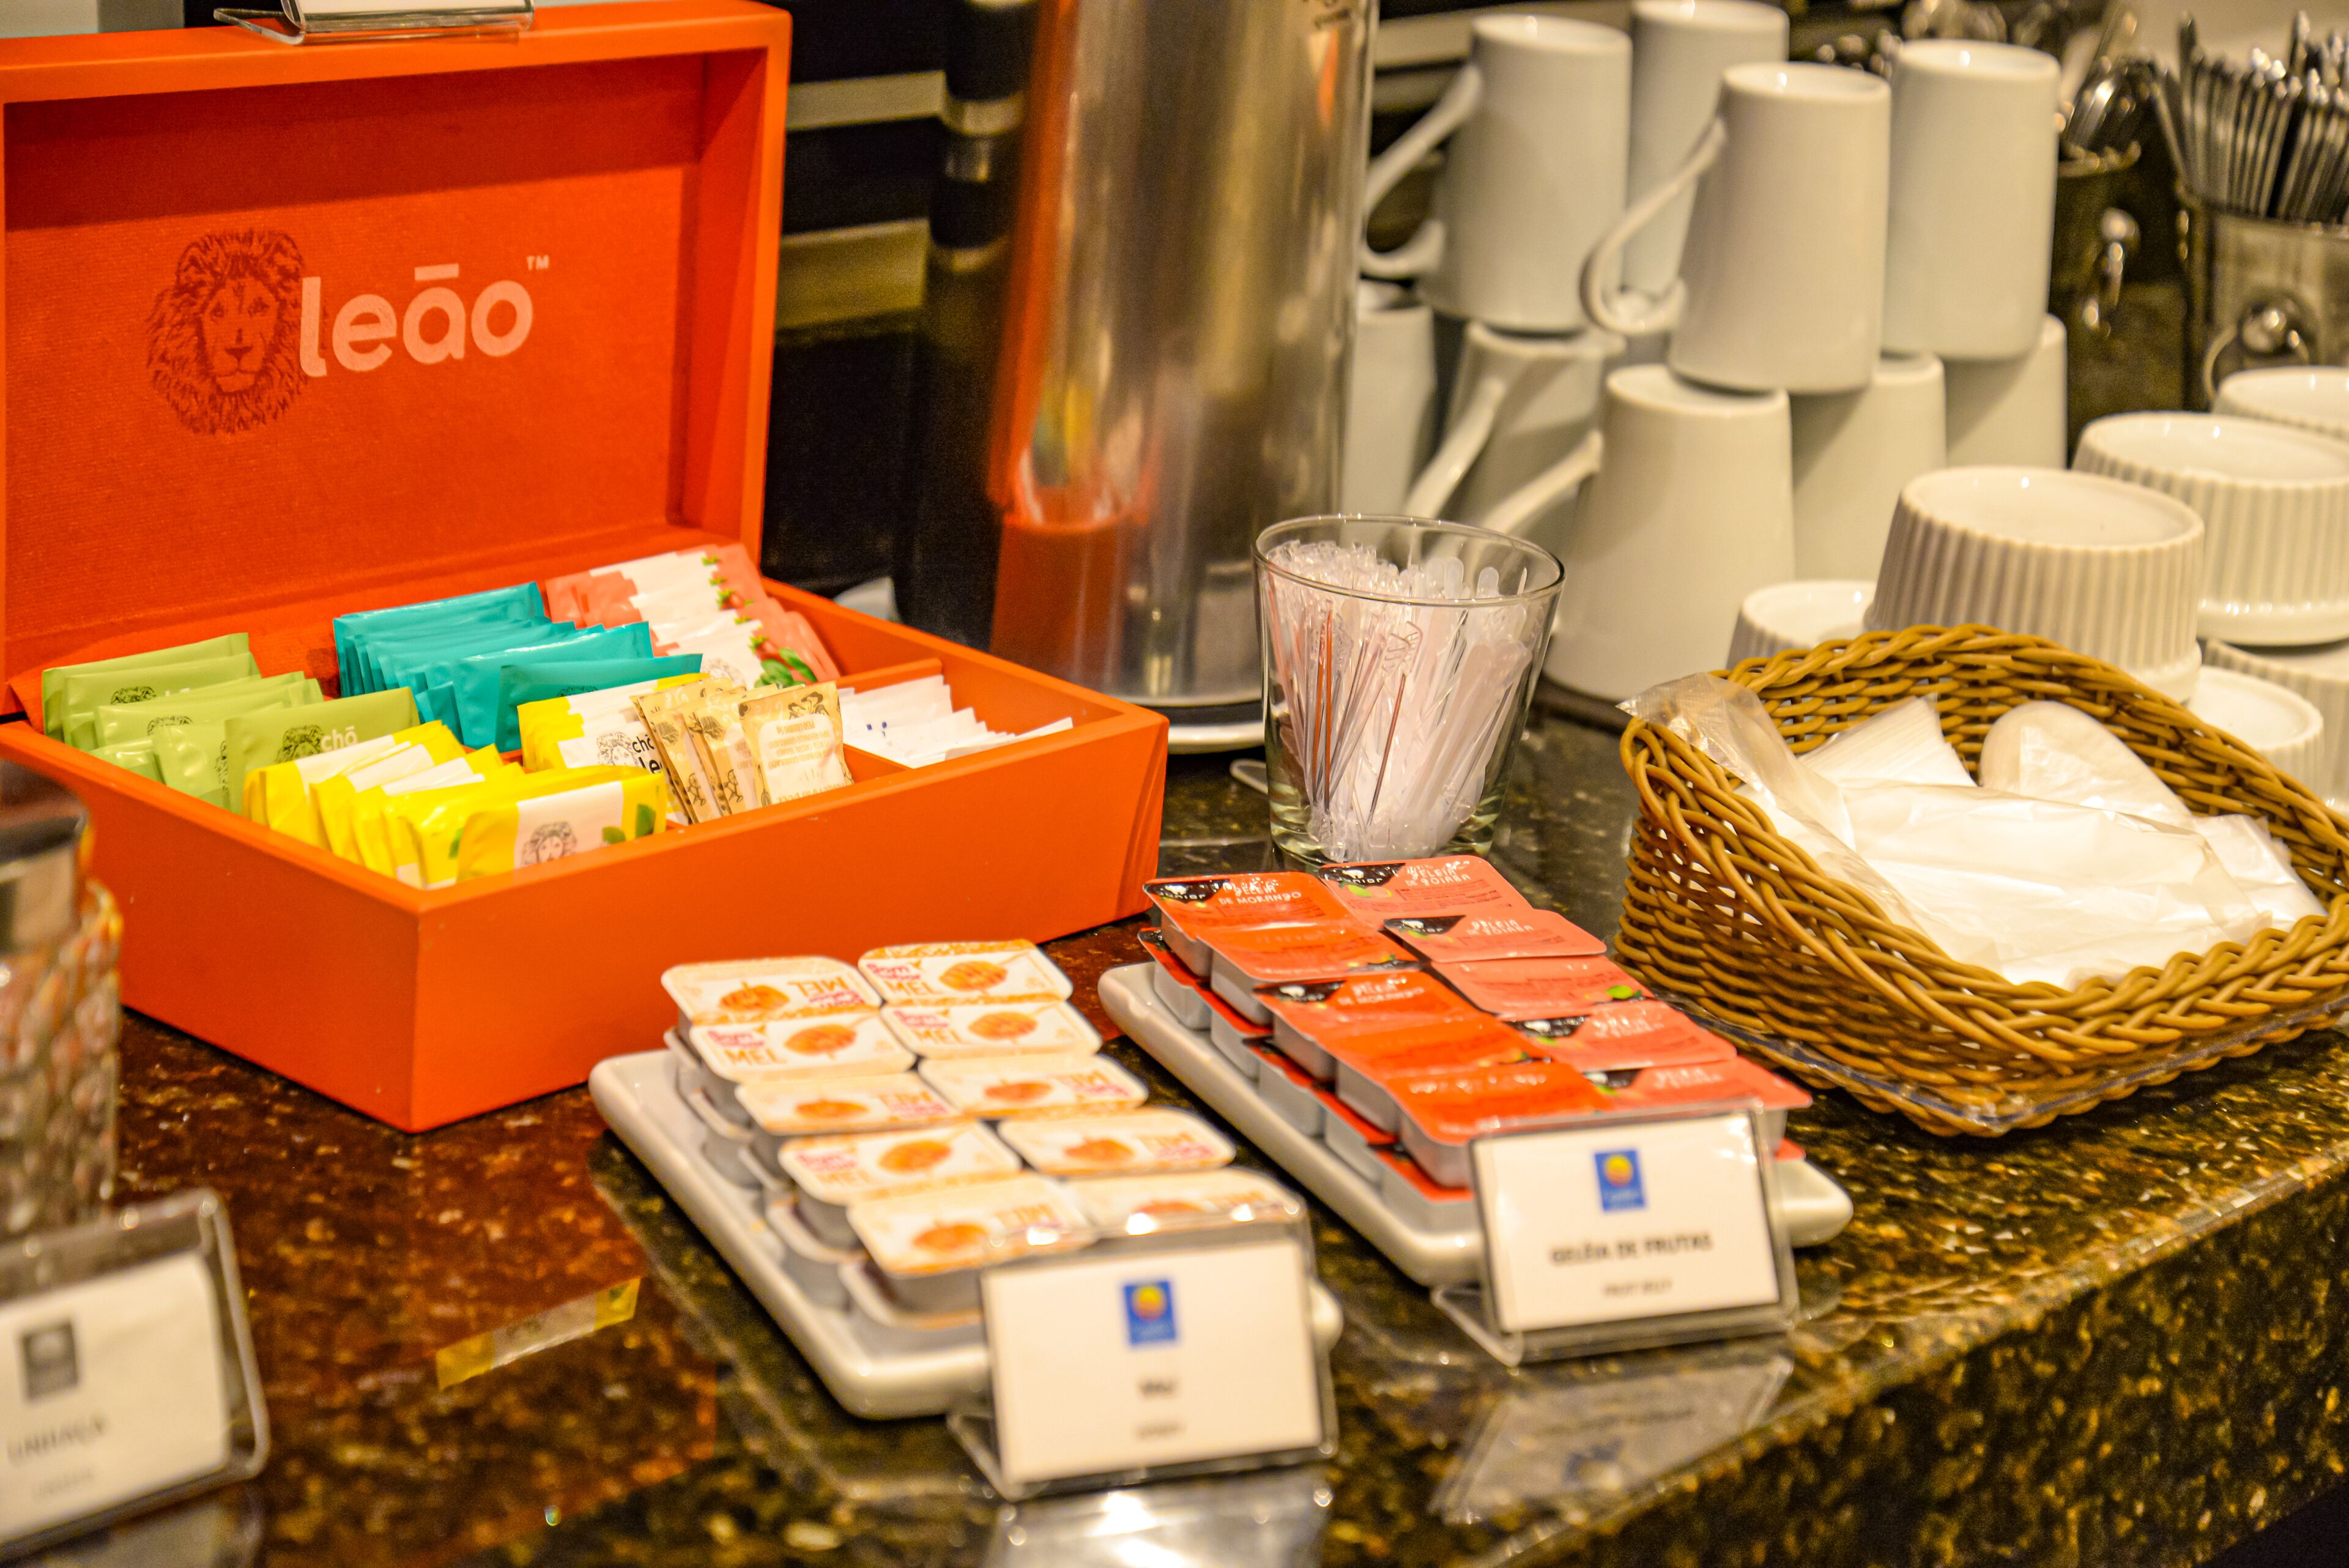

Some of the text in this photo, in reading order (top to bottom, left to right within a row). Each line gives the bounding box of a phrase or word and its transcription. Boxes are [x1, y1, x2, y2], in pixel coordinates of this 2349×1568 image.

[787, 975, 850, 998] MEL
[884, 980, 946, 995] MEL
[723, 1047, 788, 1066] MEL
